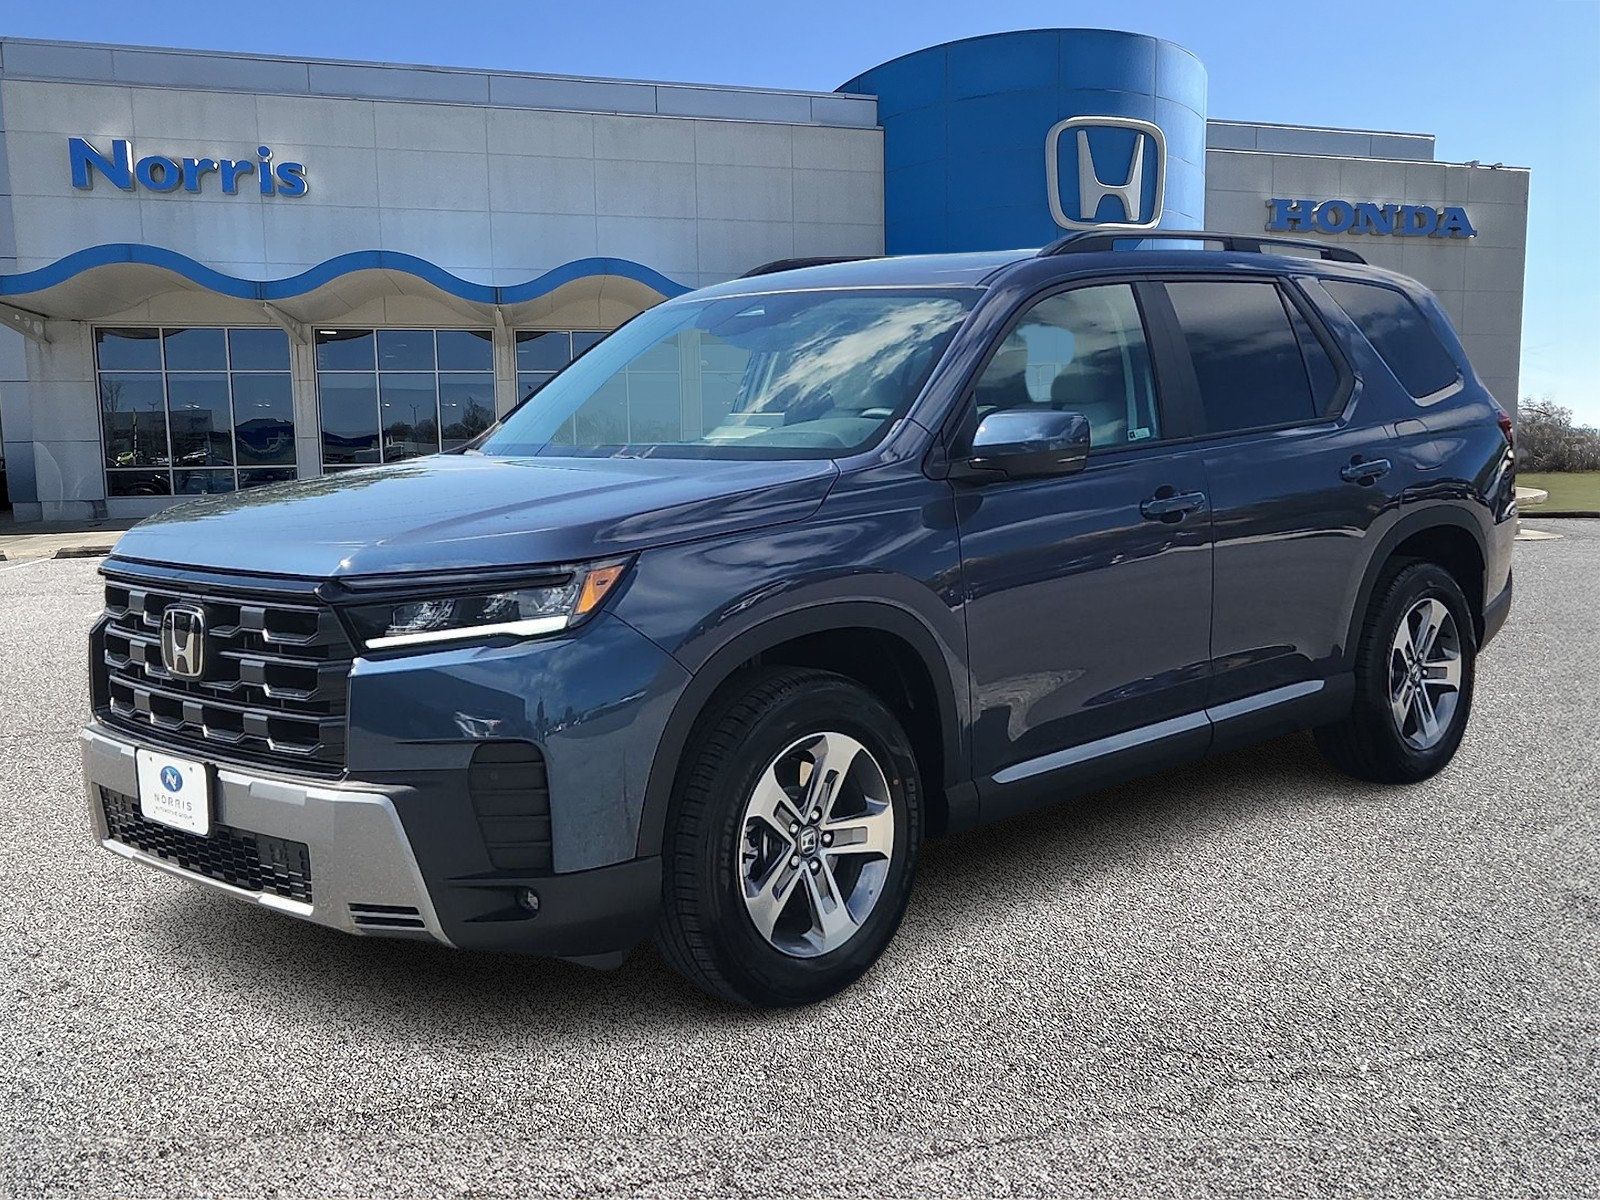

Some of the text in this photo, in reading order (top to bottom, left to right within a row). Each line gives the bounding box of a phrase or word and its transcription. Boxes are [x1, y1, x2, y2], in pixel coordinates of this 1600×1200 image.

[68, 137, 308, 198] Norris
[1265, 198, 1477, 239] HONDA
[154, 793, 193, 811] NORRIS
